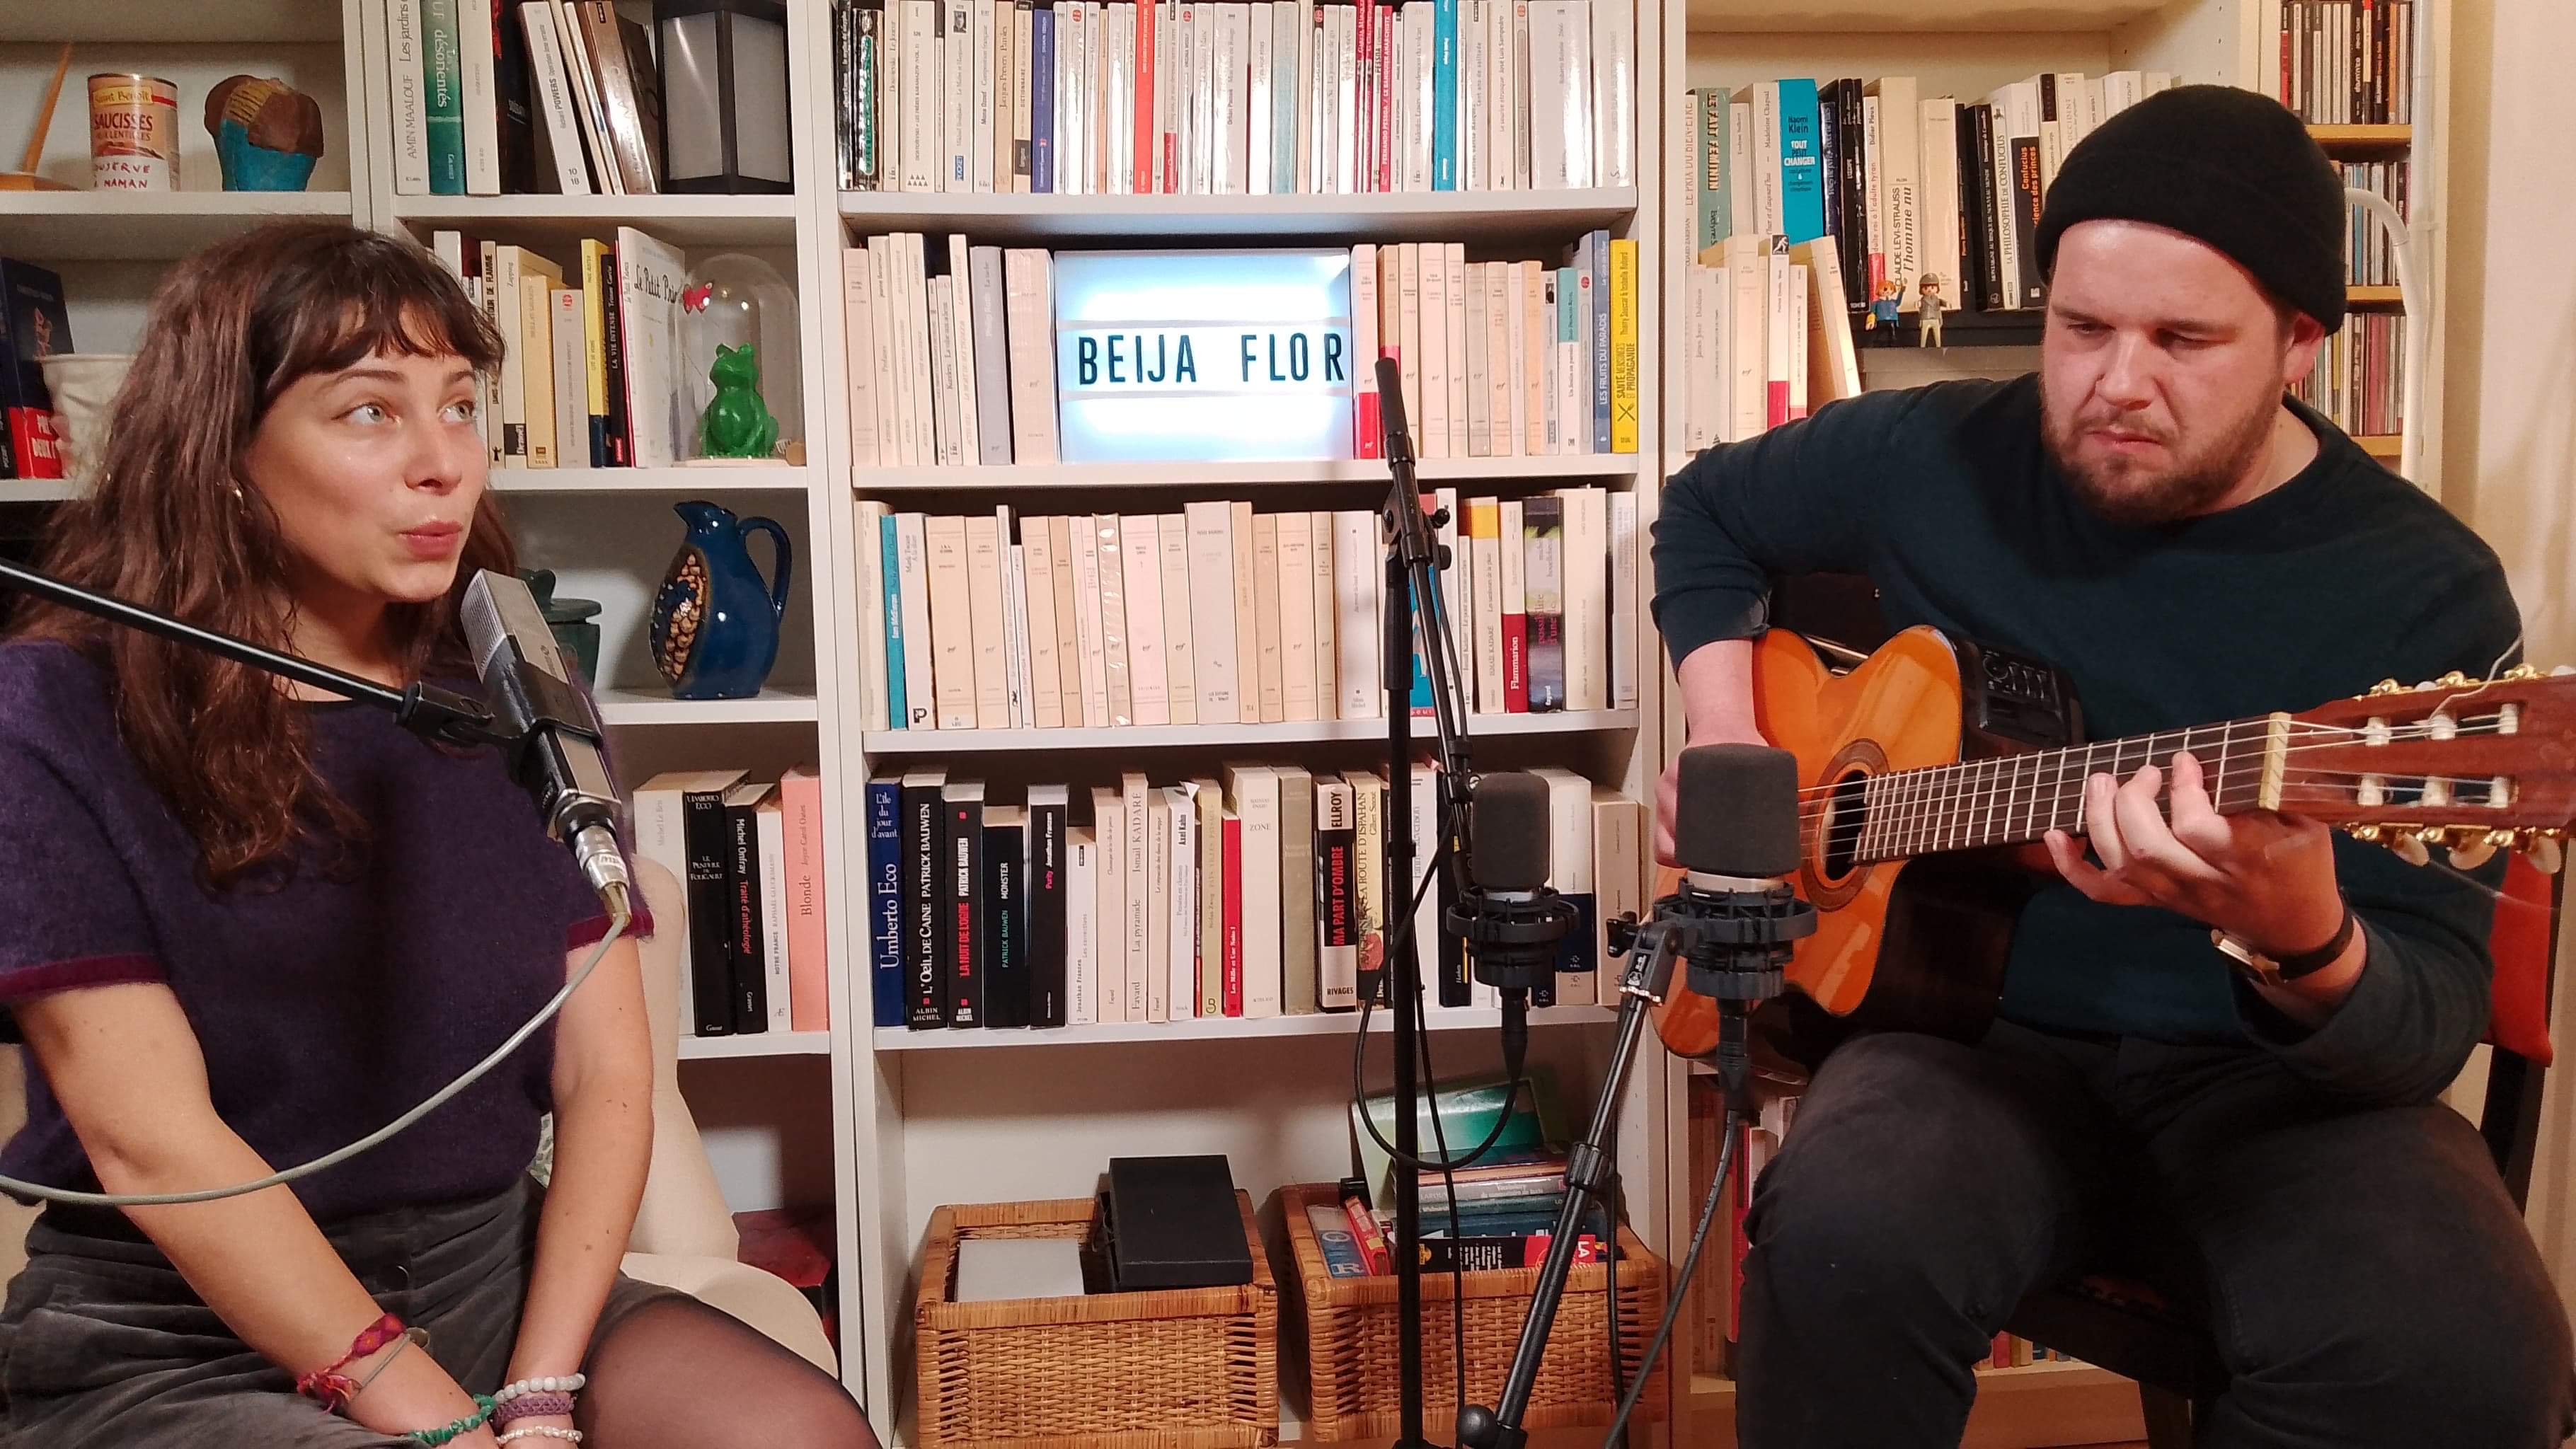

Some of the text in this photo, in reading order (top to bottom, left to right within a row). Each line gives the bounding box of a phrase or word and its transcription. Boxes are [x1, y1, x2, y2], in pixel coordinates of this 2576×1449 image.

[397, 2, 417, 158] AMIN MAALOUF Les jardins
[434, 29, 449, 108] désorientés
[548, 78, 564, 110] POWERS
[1707, 93, 1718, 108] LE
[1707, 110, 1718, 137] FAIT
[1789, 123, 1809, 133] Klein
[1791, 140, 1807, 149] TOUT
[1784, 156, 1815, 166] CHANGER
[1870, 163, 1878, 182] tyran
[1996, 135, 2008, 186] CONFUCIUS
[2029, 146, 2039, 179] princes
[1892, 187, 1902, 286] CLAUDE LEVI-STRAUSS
[1902, 187, 1914, 272] l'homme nu
[2002, 197, 2013, 255] PHILOSOPHIE
[484, 254, 493, 282] FLAMME
[634, 264, 643, 291] Le
[644, 267, 661, 298] Petit
[1618, 272, 1631, 335] Thierry Isabelle
[1598, 313, 1607, 347] PARADIS
[609, 344, 618, 356] VIE
[610, 359, 619, 369] LA
[1079, 333, 1345, 385] BEIJA FLOR
[1599, 350, 1607, 362] DU
[1599, 364, 1607, 388] FRUITS
[1625, 342, 1635, 391] PROPAGANDE
[1548, 616, 1558, 645] d'une
[1510, 636, 1519, 690] Flammarion
[876, 793, 891, 804] L'île
[879, 807, 889, 816] du
[1330, 792, 1342, 828] ELLROY
[798, 804, 807, 824] Oates
[876, 819, 892, 829] jour
[920, 803, 930, 852] BAUWEN
[1249, 823, 1271, 831] ZONE
[736, 818, 745, 845] Michel
[871, 828, 897, 839] d'avant
[1178, 814, 1187, 845] Axel Kahn
[1357, 792, 1367, 884] ROUTE D'ISPAHAN
[737, 846, 747, 875] Onfray
[958, 838, 969, 866] BAUWEN
[1045, 840, 1053, 868] Jonathan
[921, 855, 931, 897] PATRICK
[958, 867, 969, 897] PATRICK
[739, 881, 748, 906] Traité
[799, 874, 813, 916] Blonde
[1130, 792, 1142, 1010] Fayard La pyramide KADARÉ
[1331, 846, 1345, 945] MA PART D'OMBRE
[877, 863, 899, 970] Umberto Eco
[922, 939, 931, 955] DE
[959, 944, 970, 964] NUIT
[960, 965, 970, 976] LA
[1327, 987, 1354, 995] RIVAGES
